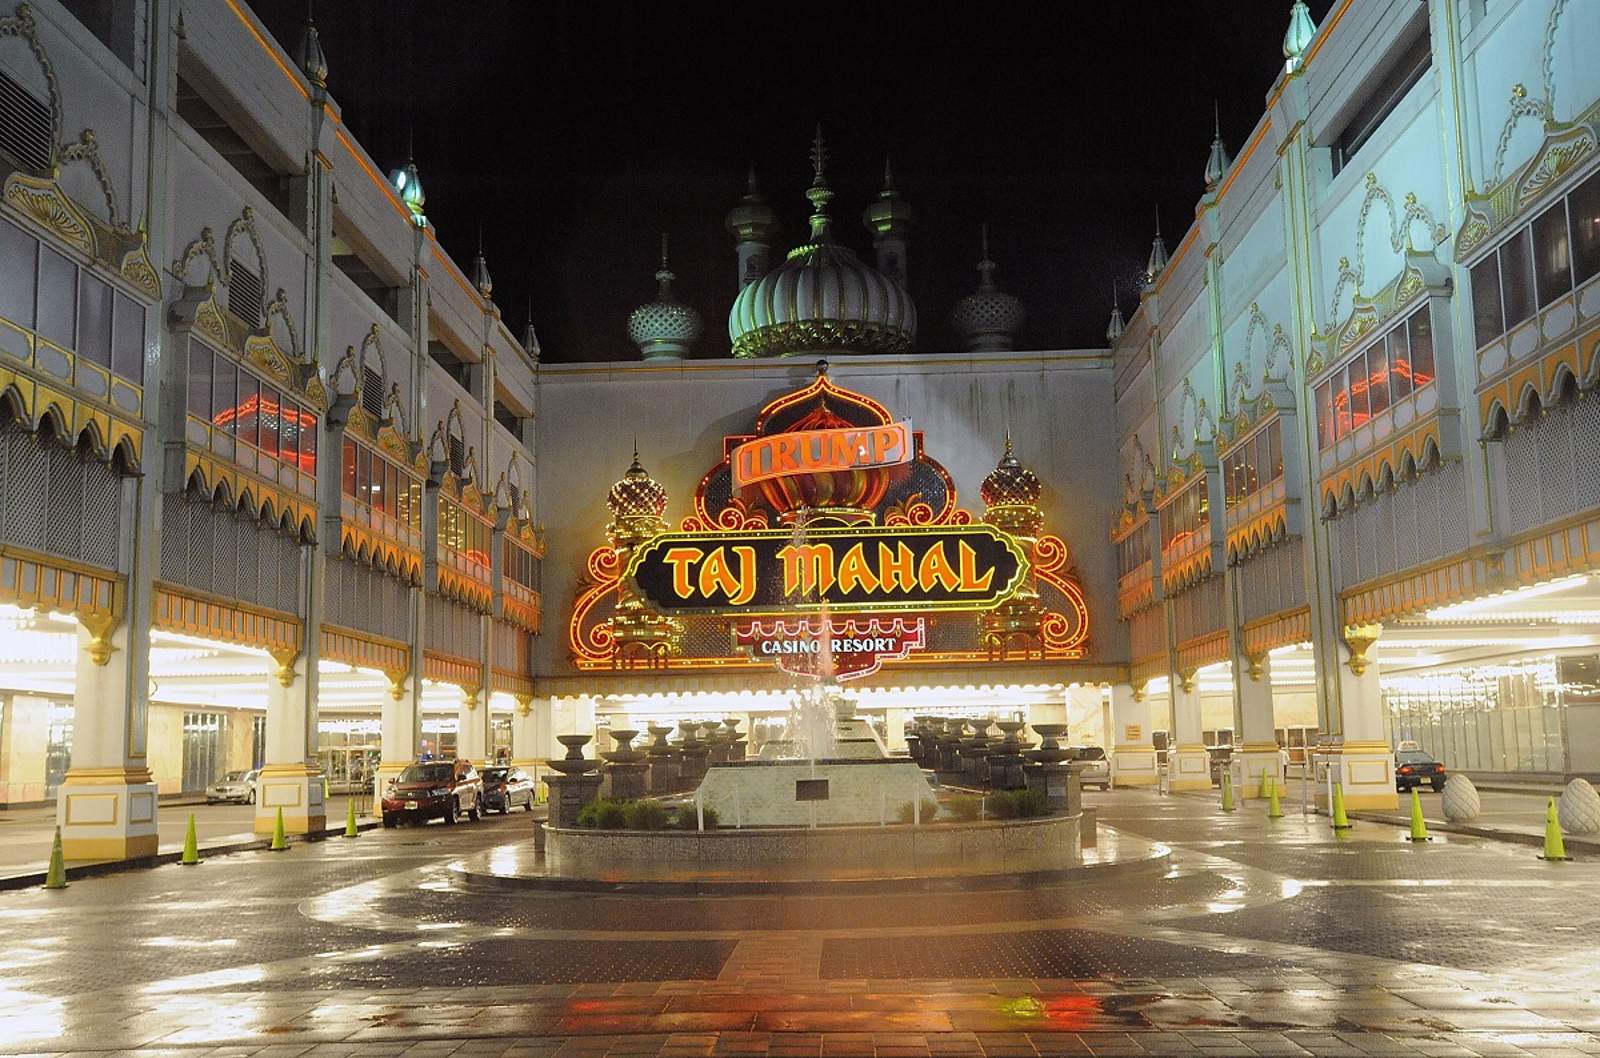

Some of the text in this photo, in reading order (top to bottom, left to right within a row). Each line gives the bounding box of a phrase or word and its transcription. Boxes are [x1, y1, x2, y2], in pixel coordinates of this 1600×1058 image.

[743, 430, 899, 476] TRUMP
[663, 539, 995, 605] TAJ MAHAL
[761, 638, 896, 654] CASINO RESORT
